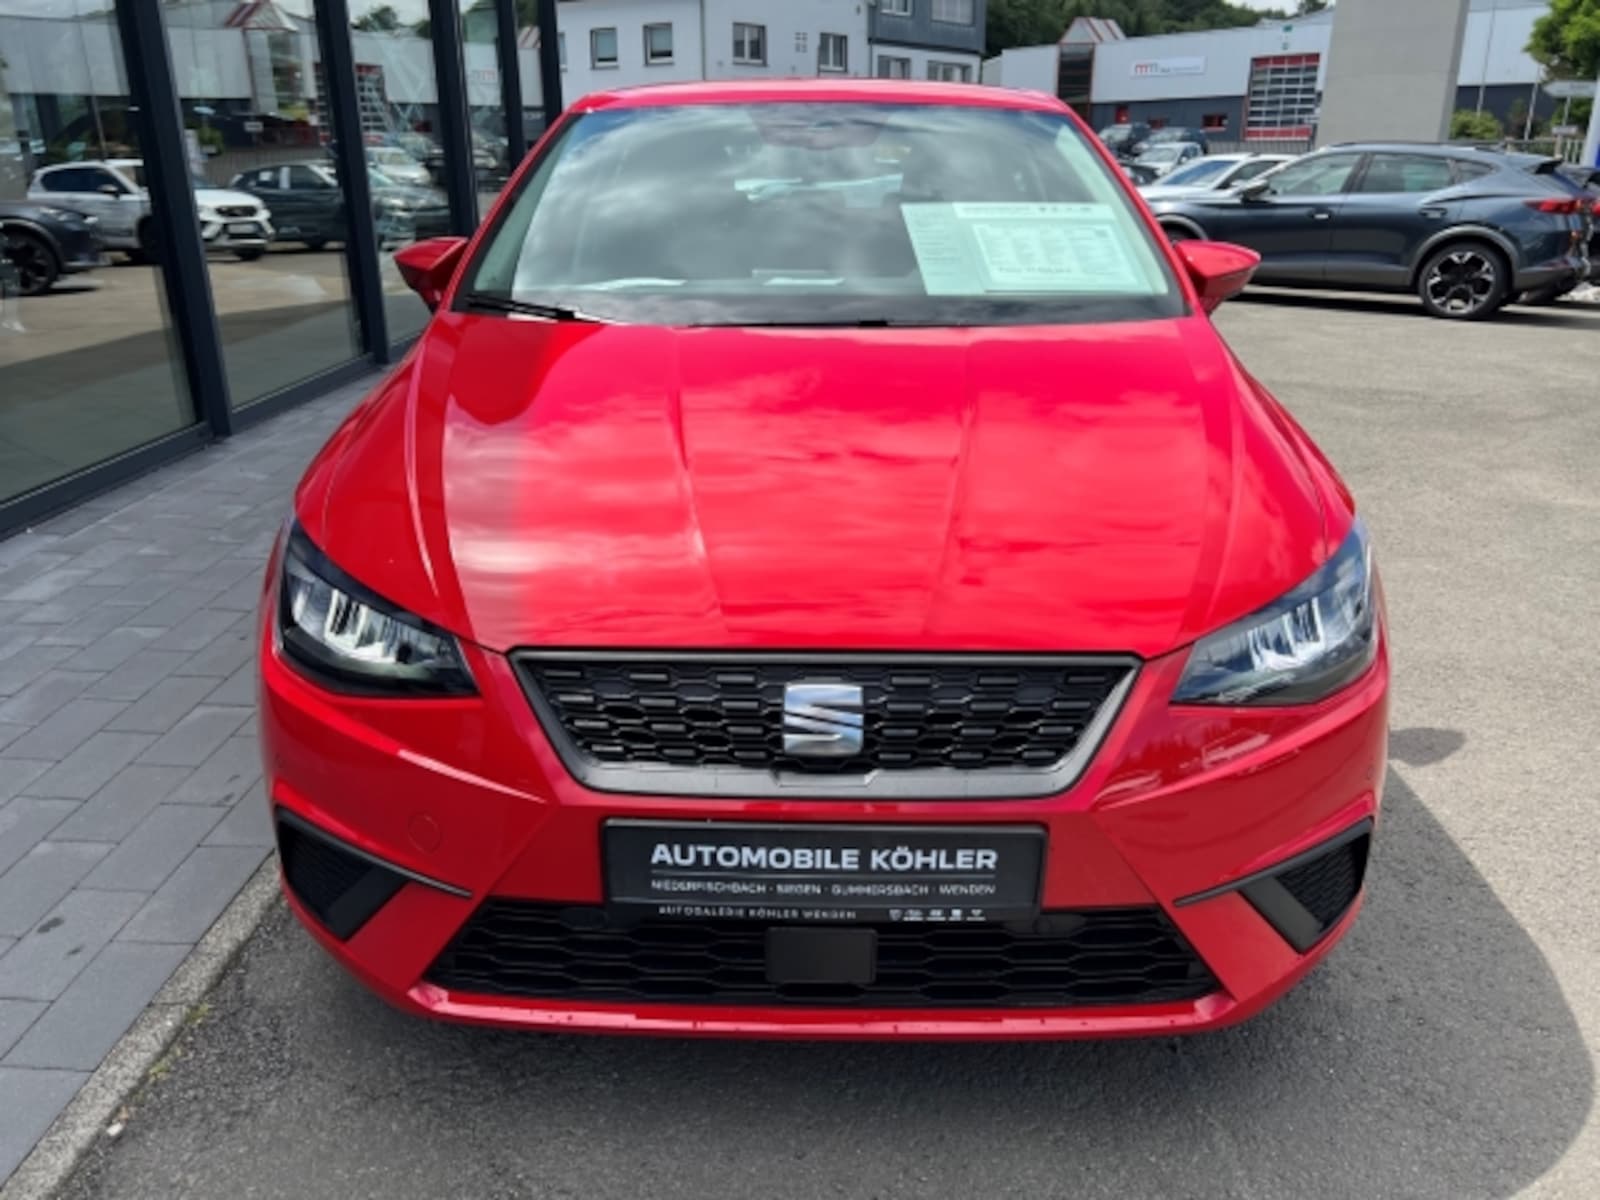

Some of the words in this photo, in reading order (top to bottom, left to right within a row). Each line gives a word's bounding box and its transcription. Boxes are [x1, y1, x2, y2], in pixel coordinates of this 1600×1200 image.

[651, 843, 860, 870] AUTOMOBILE
[870, 845, 999, 871] KÖHLER
[831, 883, 929, 897] GUMMERSBACH
[938, 883, 997, 896] WENDEN
[748, 906, 799, 920] KÖHLER
